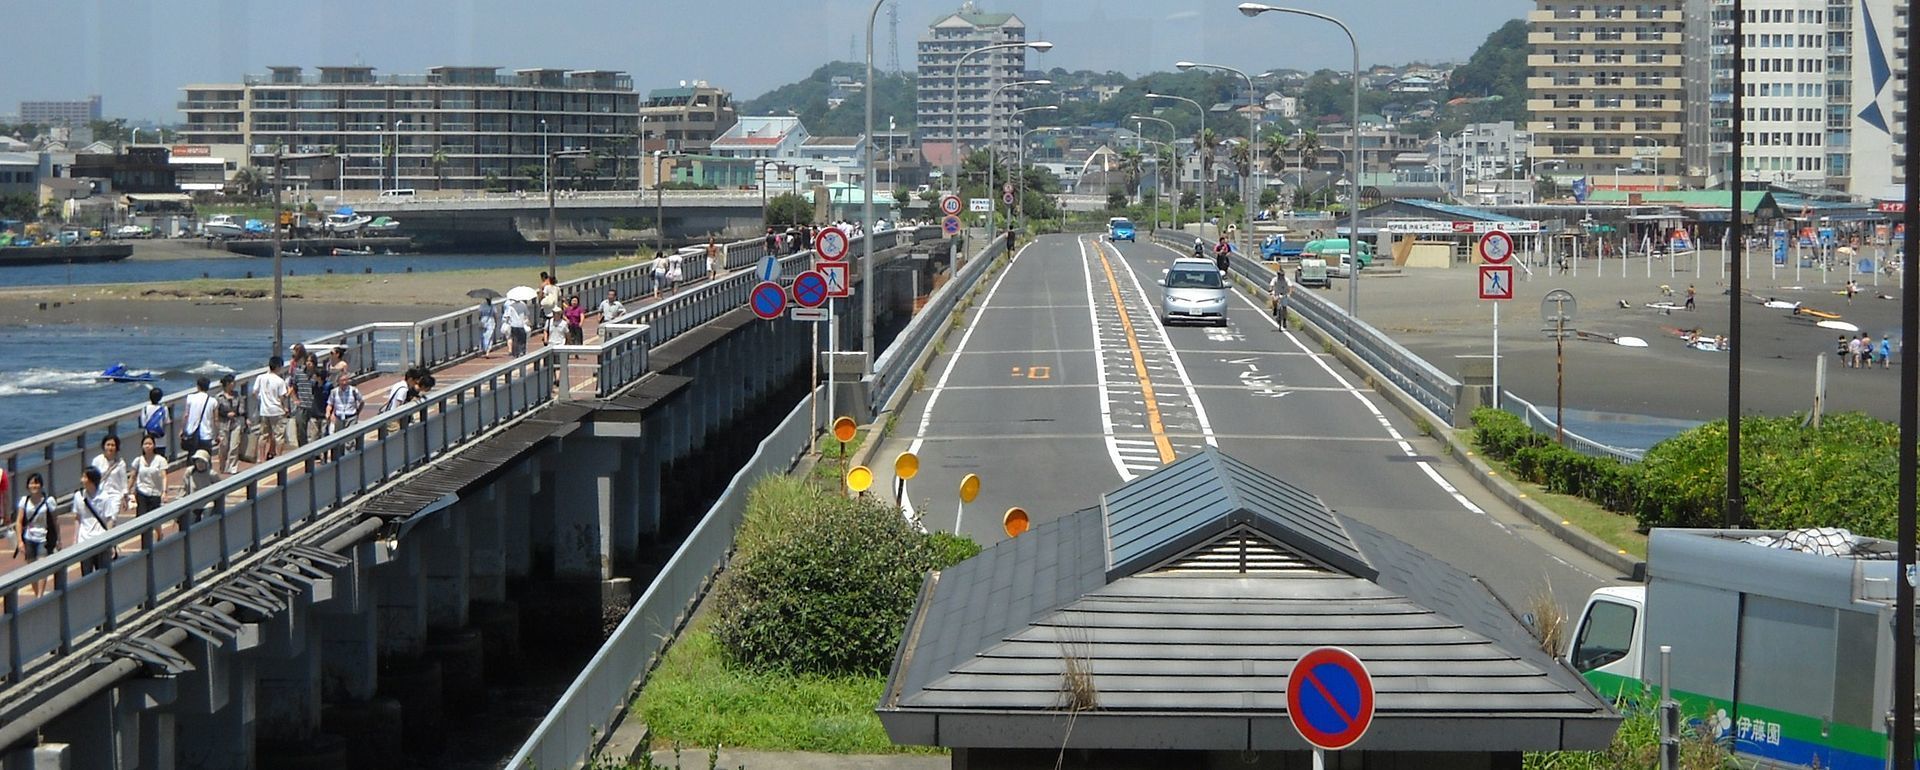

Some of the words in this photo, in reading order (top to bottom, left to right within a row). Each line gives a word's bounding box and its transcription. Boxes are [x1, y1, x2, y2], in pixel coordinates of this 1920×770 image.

[947, 200, 957, 210] 40
[1736, 715, 1781, 746] 伊藤園
